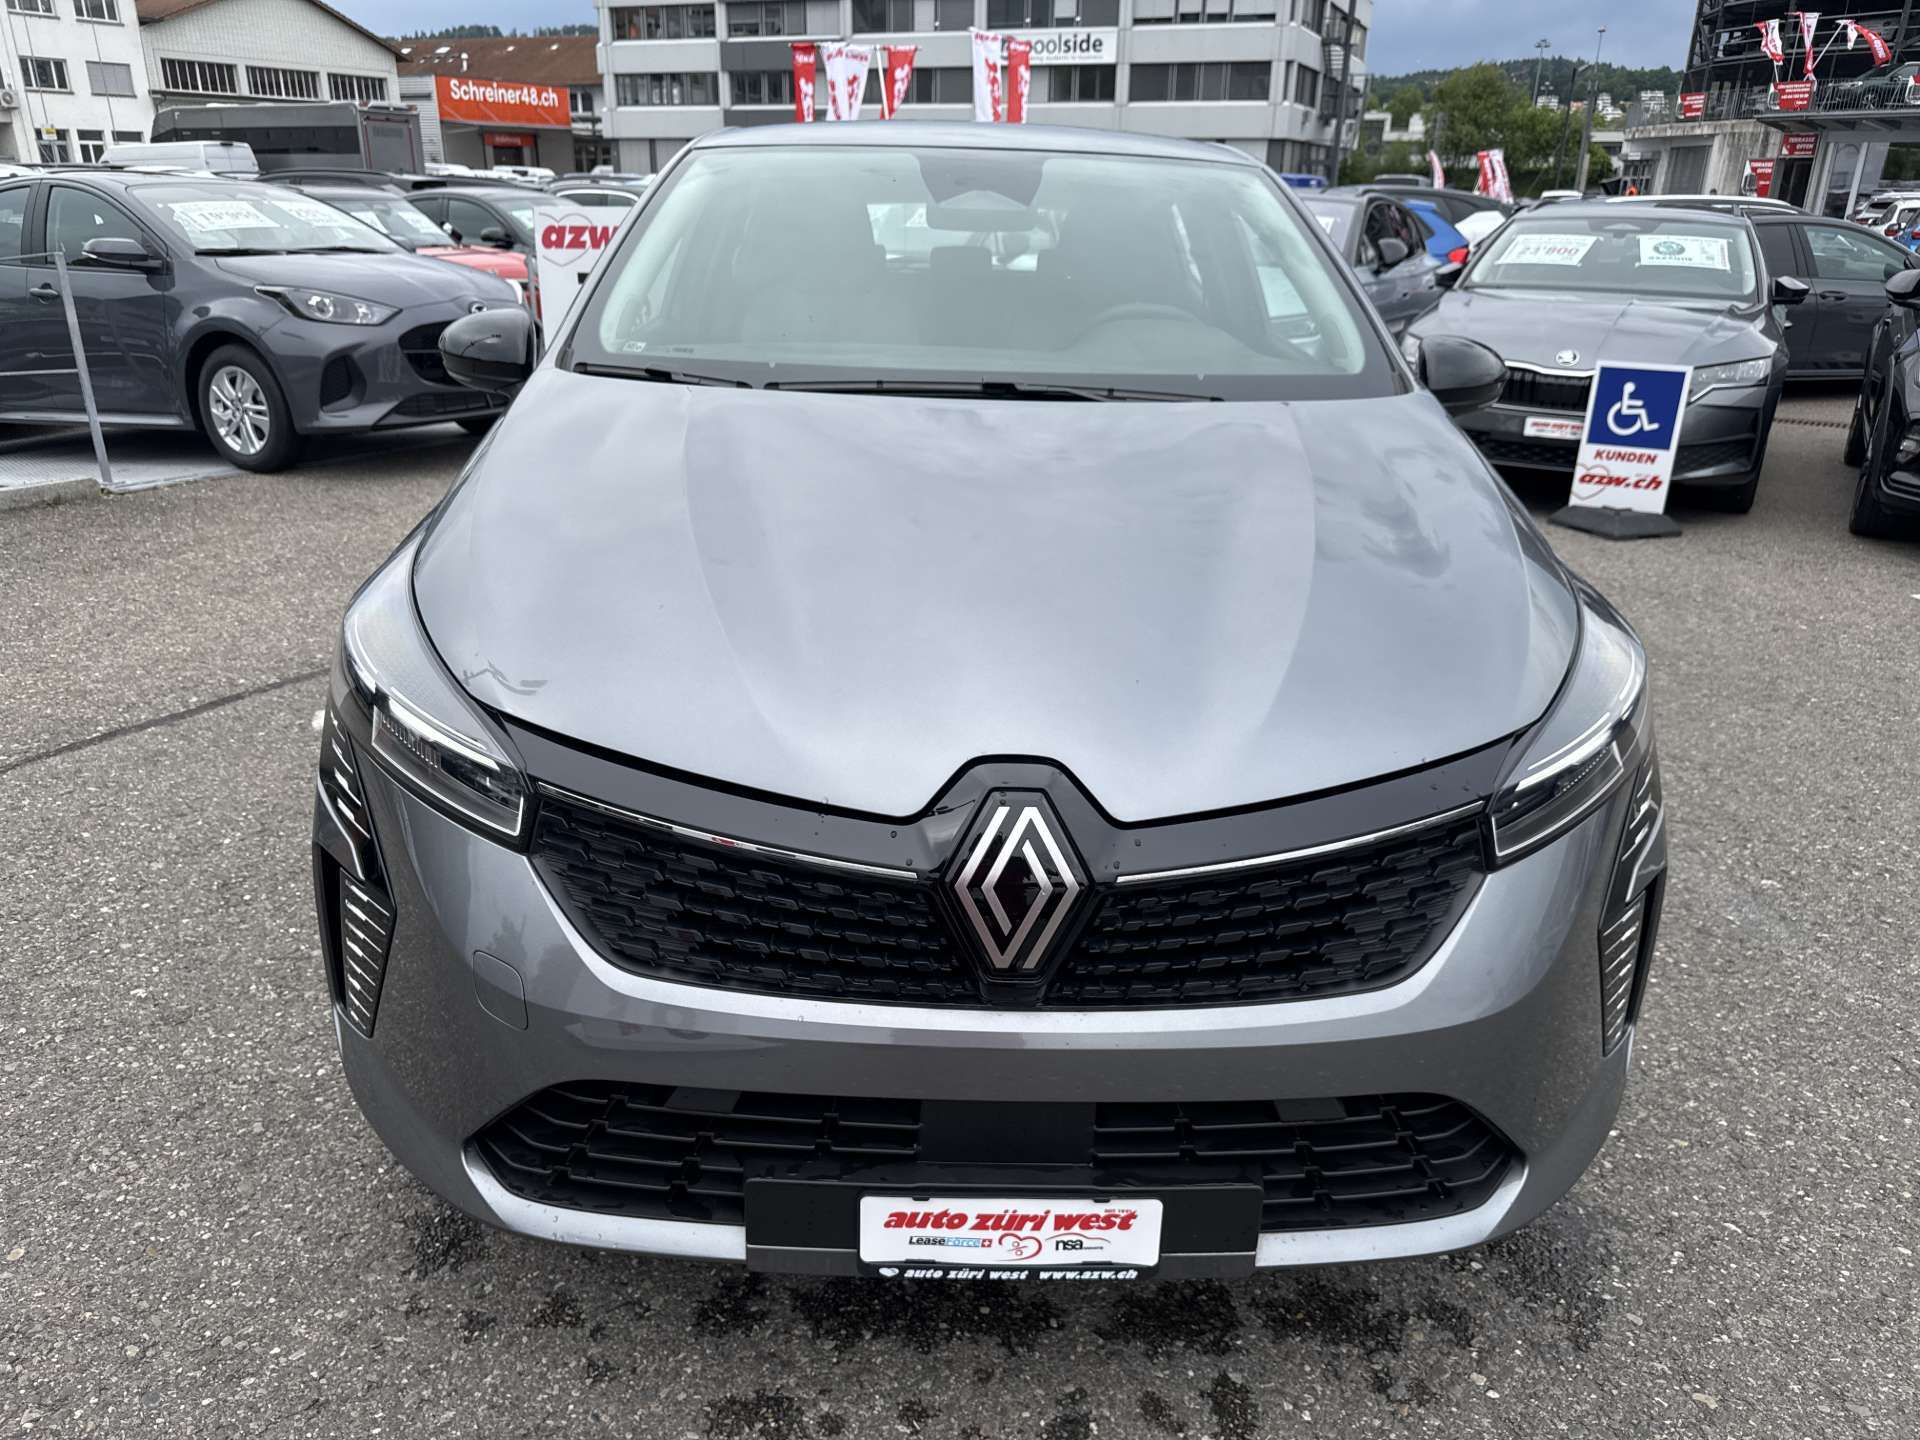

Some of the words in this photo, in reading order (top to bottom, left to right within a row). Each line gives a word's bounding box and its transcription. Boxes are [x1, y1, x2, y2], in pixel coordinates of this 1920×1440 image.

[1028, 33, 1103, 54] oolside
[449, 79, 559, 108] Schreiner48.ch
[1593, 449, 1658, 465] KUNDEN
[1578, 473, 1663, 491] azw.ch
[883, 1208, 969, 1230] auto
[969, 1208, 1051, 1232] züri
[1053, 1211, 1138, 1231] west
[1055, 1239, 1083, 1251] nsa
[903, 1268, 944, 1279] auto
[946, 1268, 985, 1280] züri
[989, 1269, 1029, 1280] west
[1039, 1269, 1139, 1280] www.azw.ch
